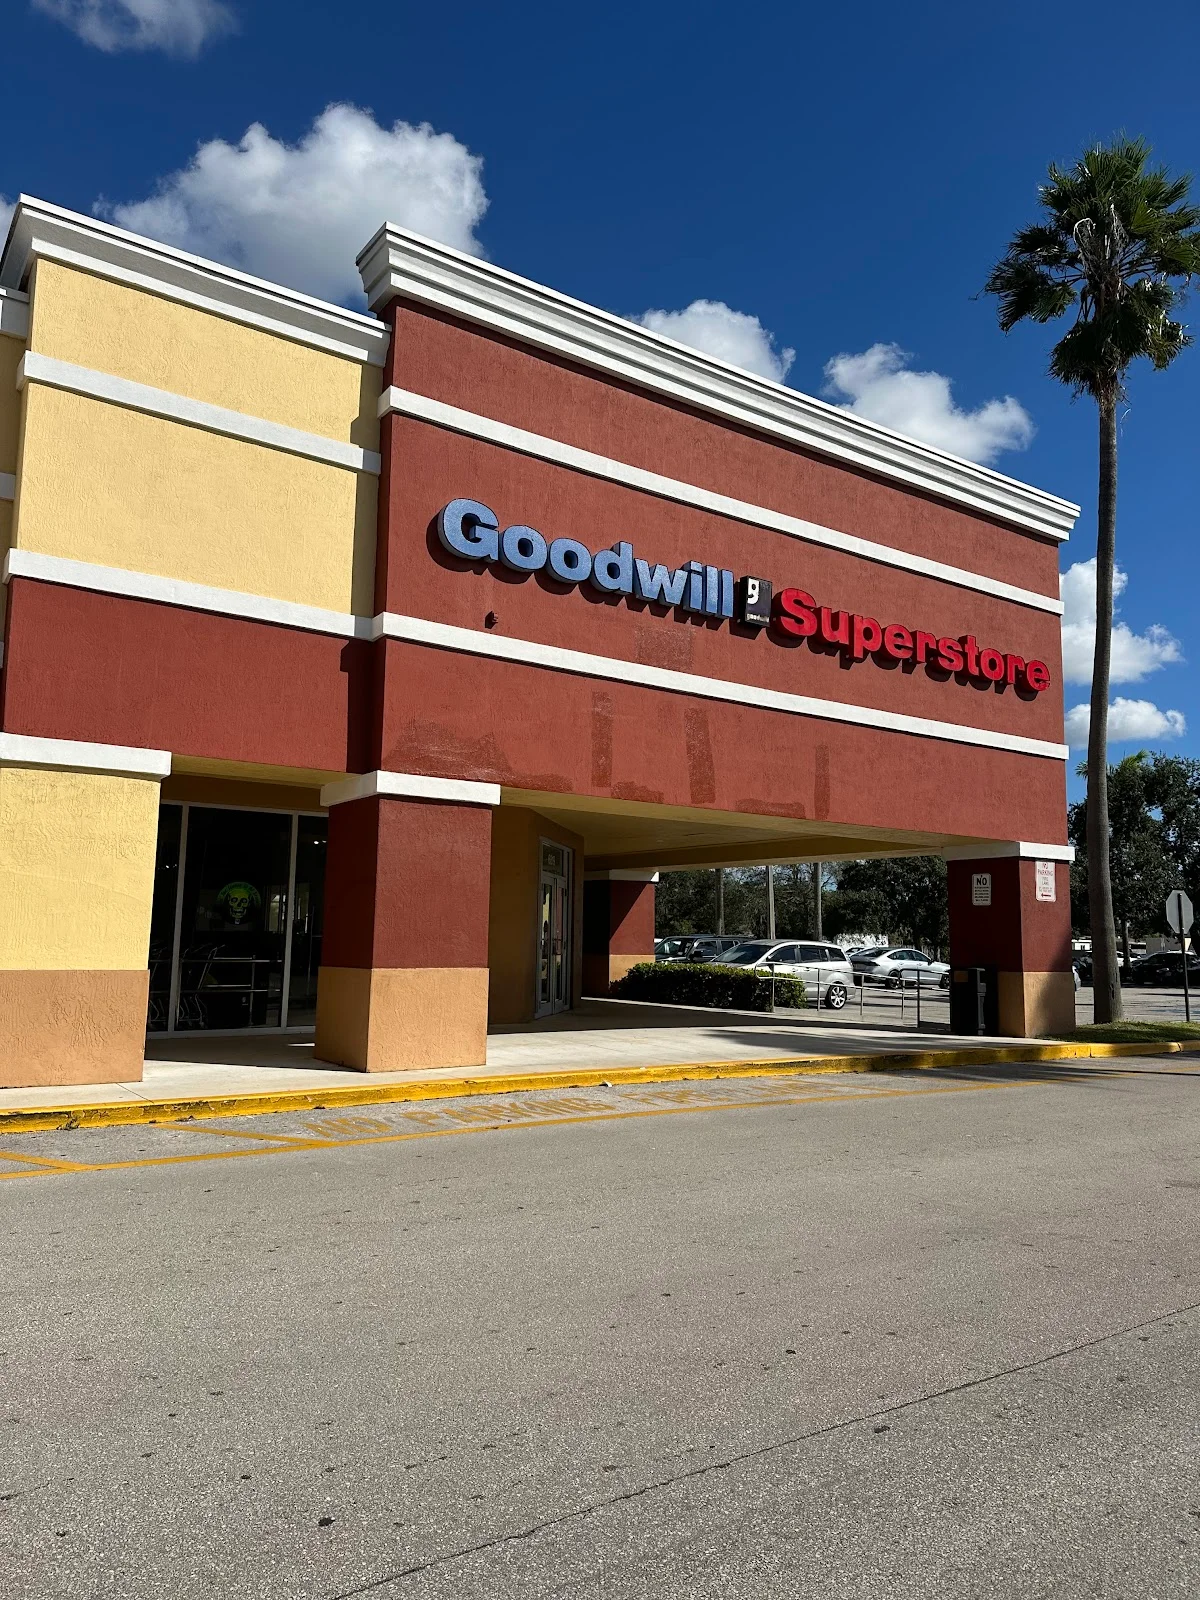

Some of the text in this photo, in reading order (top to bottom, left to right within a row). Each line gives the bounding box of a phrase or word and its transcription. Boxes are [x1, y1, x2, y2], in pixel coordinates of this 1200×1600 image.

[440, 497, 1051, 692] Goodwill Superstore
[976, 877, 988, 886] NO
[302, 1116, 393, 1138] NO
[402, 1096, 616, 1127] PARKING
